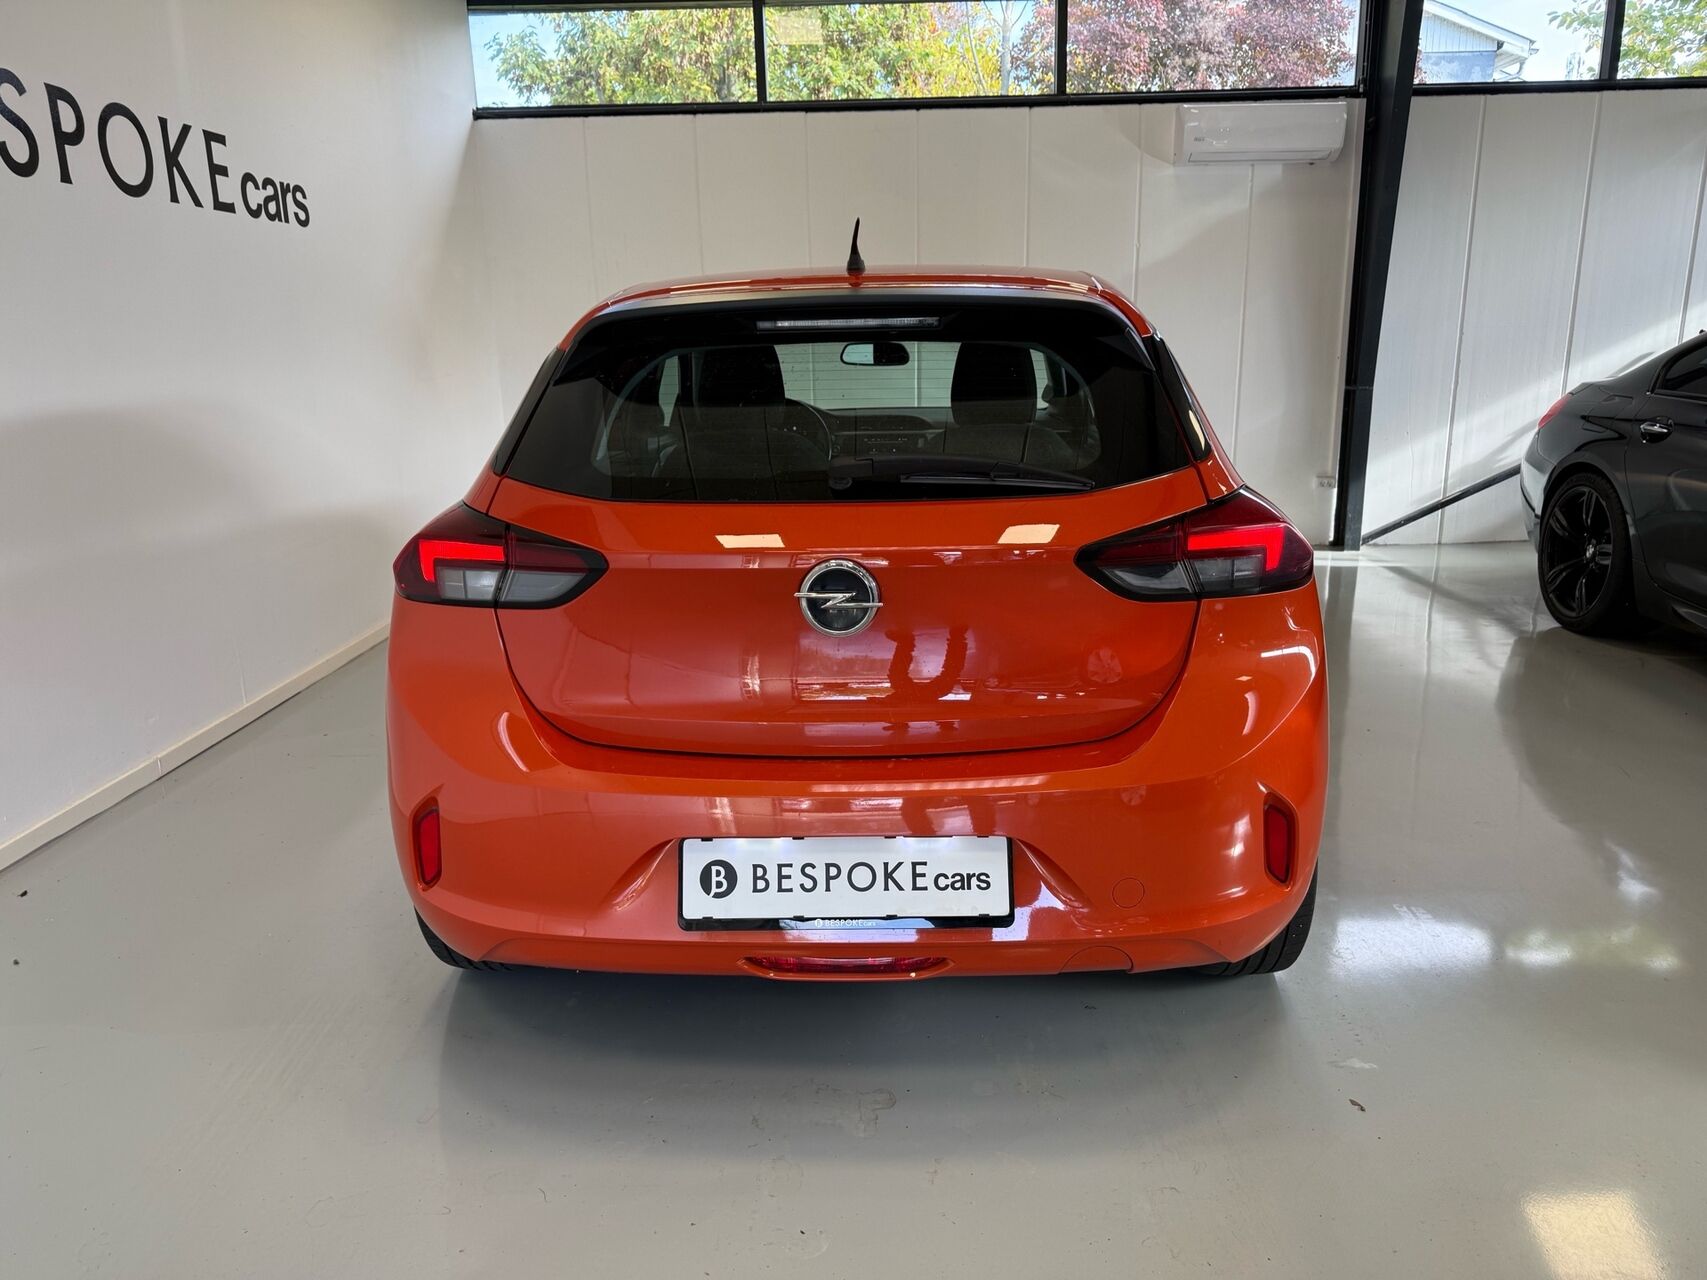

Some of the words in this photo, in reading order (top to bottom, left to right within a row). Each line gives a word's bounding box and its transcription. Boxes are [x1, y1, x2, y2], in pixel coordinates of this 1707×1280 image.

[240, 171, 310, 227] cars
[752, 862, 928, 893] BESPOKE
[933, 872, 991, 891] cars
[825, 919, 863, 927] BESPOKE
